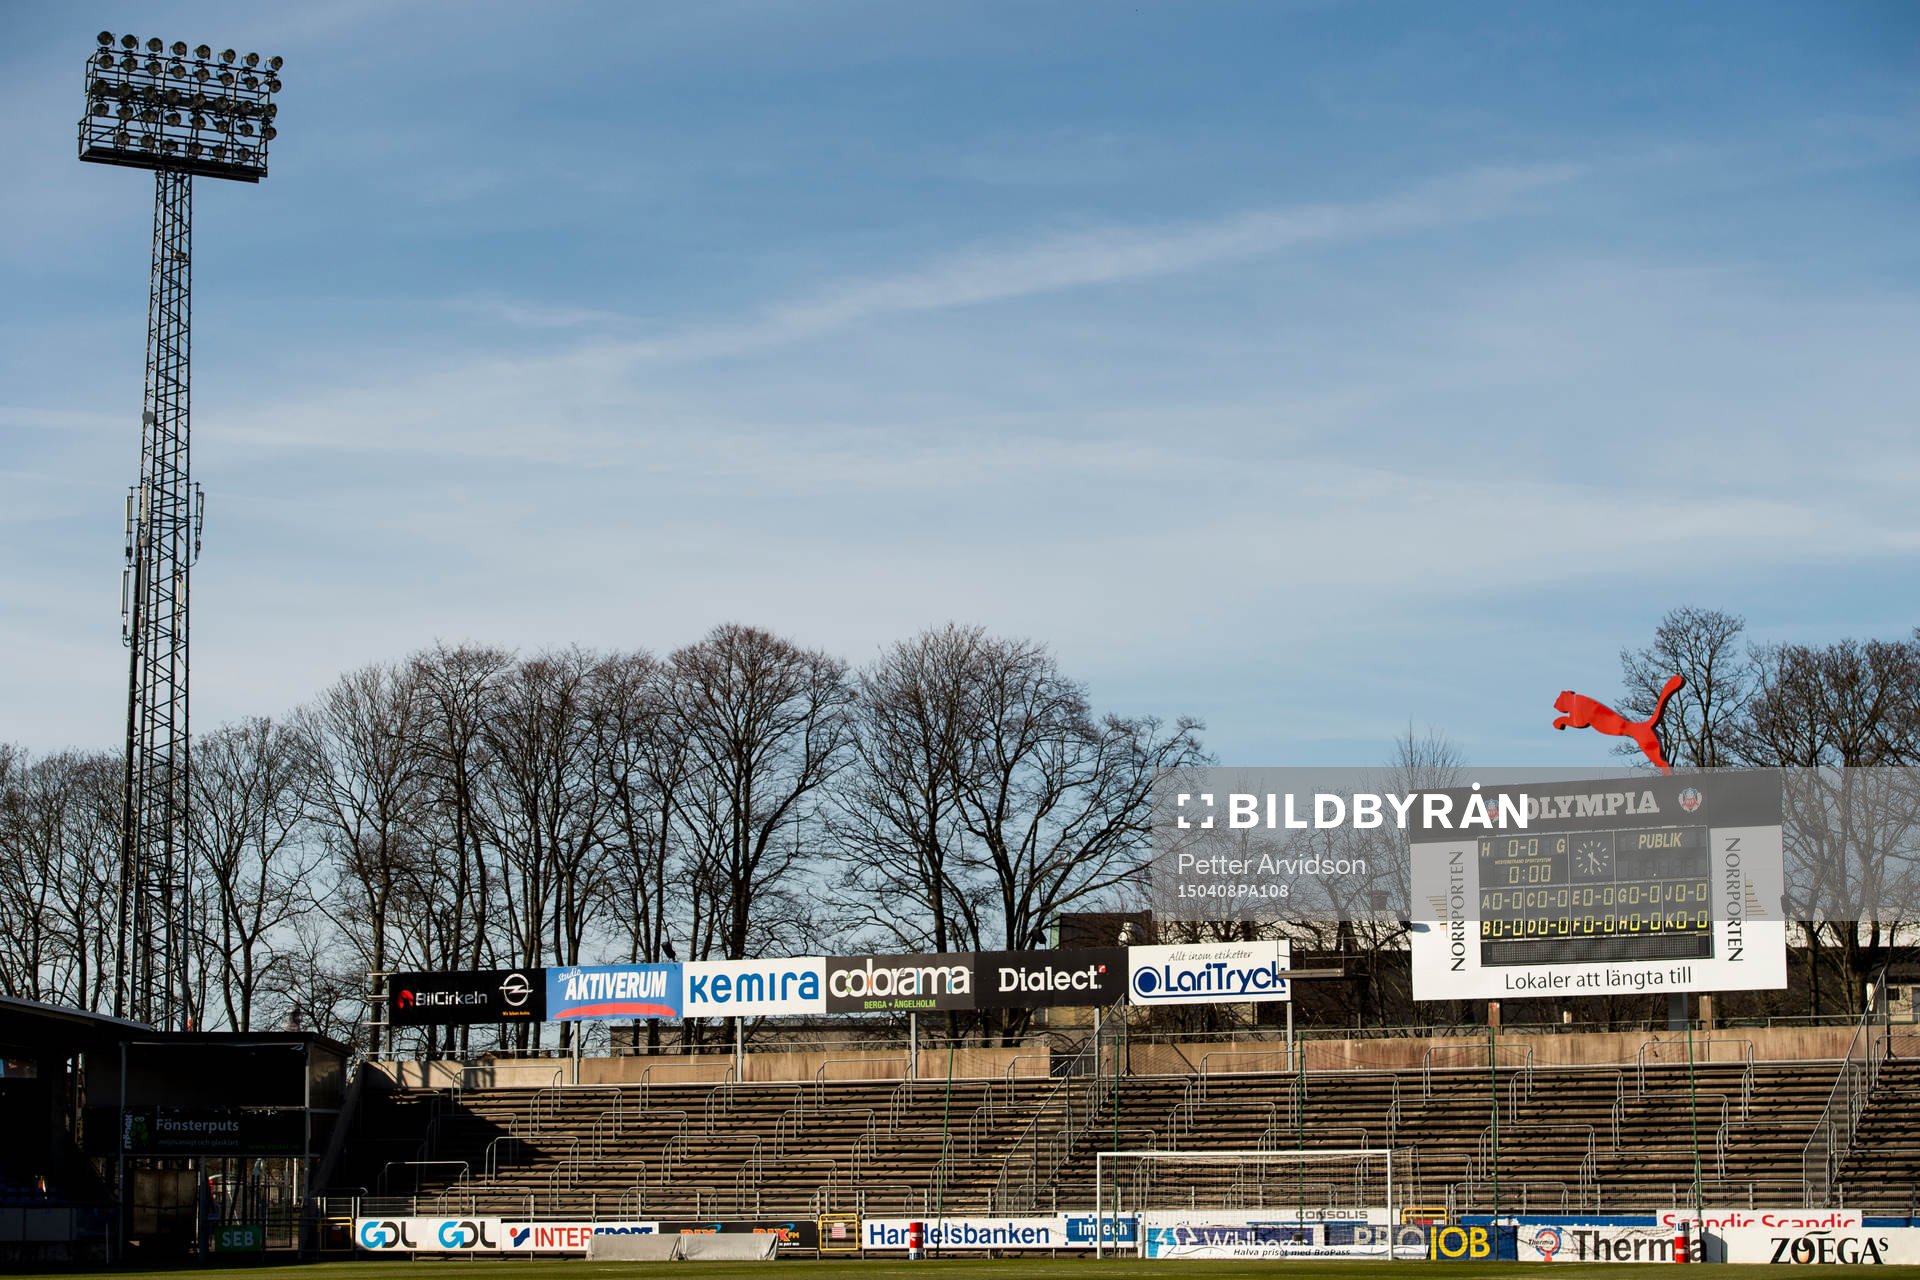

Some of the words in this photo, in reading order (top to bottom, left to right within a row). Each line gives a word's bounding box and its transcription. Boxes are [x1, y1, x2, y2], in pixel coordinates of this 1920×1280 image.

[1526, 790, 1660, 820] OLYMPIA
[1638, 832, 1683, 849] PUBLIK
[1508, 864, 1551, 884] 0:00
[1724, 837, 1744, 962] NORRPORTEN
[1449, 850, 1466, 972] NORRPORTEN
[1168, 951, 1186, 961] Allt
[1188, 951, 1211, 960] inom
[1214, 948, 1253, 959] etiketter
[564, 970, 667, 1001] AKTIVERUM
[690, 970, 820, 1003] kemira
[829, 958, 971, 998] colorama
[998, 965, 1101, 993] Dialect
[1164, 961, 1286, 993] LariTryck
[1505, 969, 1573, 990] Lokaler
[1576, 970, 1600, 987] att
[1605, 969, 1664, 991] längta
[1669, 966, 1692, 984] till
[416, 991, 488, 1006] BilCirkeln
[864, 1001, 887, 1009] BERGA
[155, 1117, 239, 1134] Fönsterputs
[1295, 1210, 1368, 1220] CONSOLIS
[222, 1231, 254, 1247] SEB
[870, 1223, 1049, 1245] Handelsbanken
[1079, 1222, 1128, 1236] Imech
[1234, 1248, 1259, 1256] Halva
[1262, 1248, 1288, 1258] priset
[1291, 1248, 1310, 1256] med
[1573, 1230, 1707, 1261] Therma
